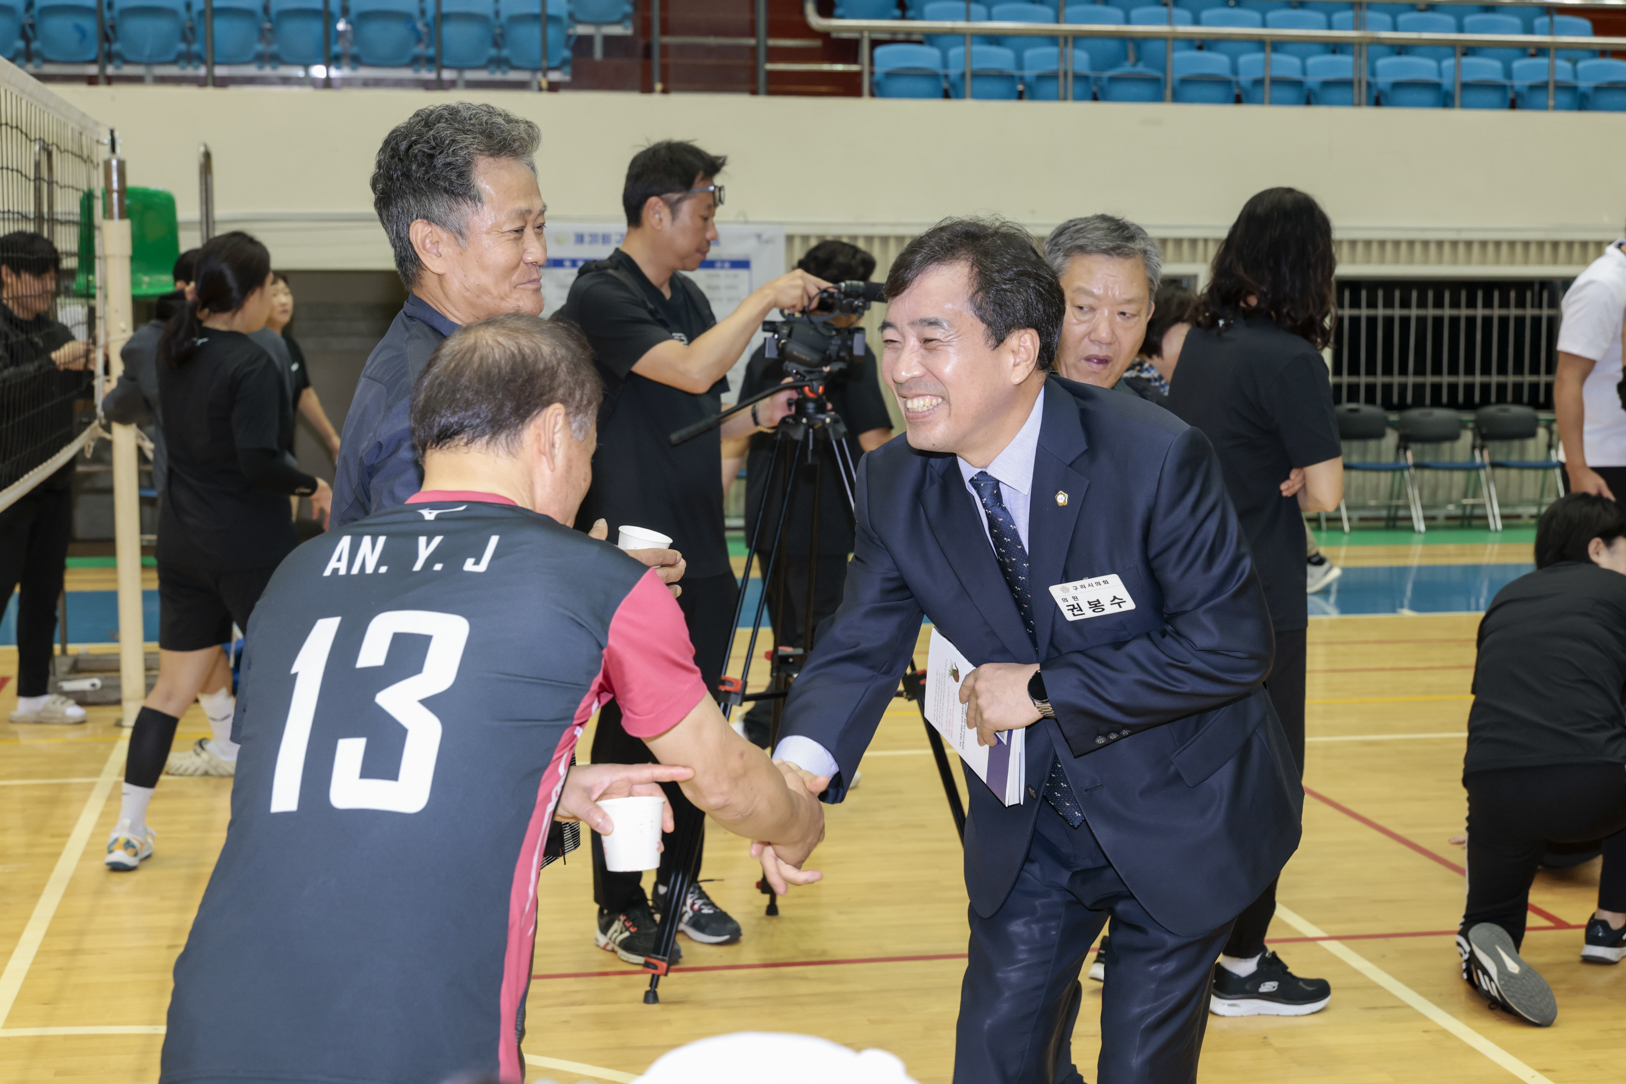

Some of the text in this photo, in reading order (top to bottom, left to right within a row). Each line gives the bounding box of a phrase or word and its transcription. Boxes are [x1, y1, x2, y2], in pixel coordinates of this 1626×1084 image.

[323, 535, 500, 576] AN. Y. J
[270, 610, 470, 814] 13
